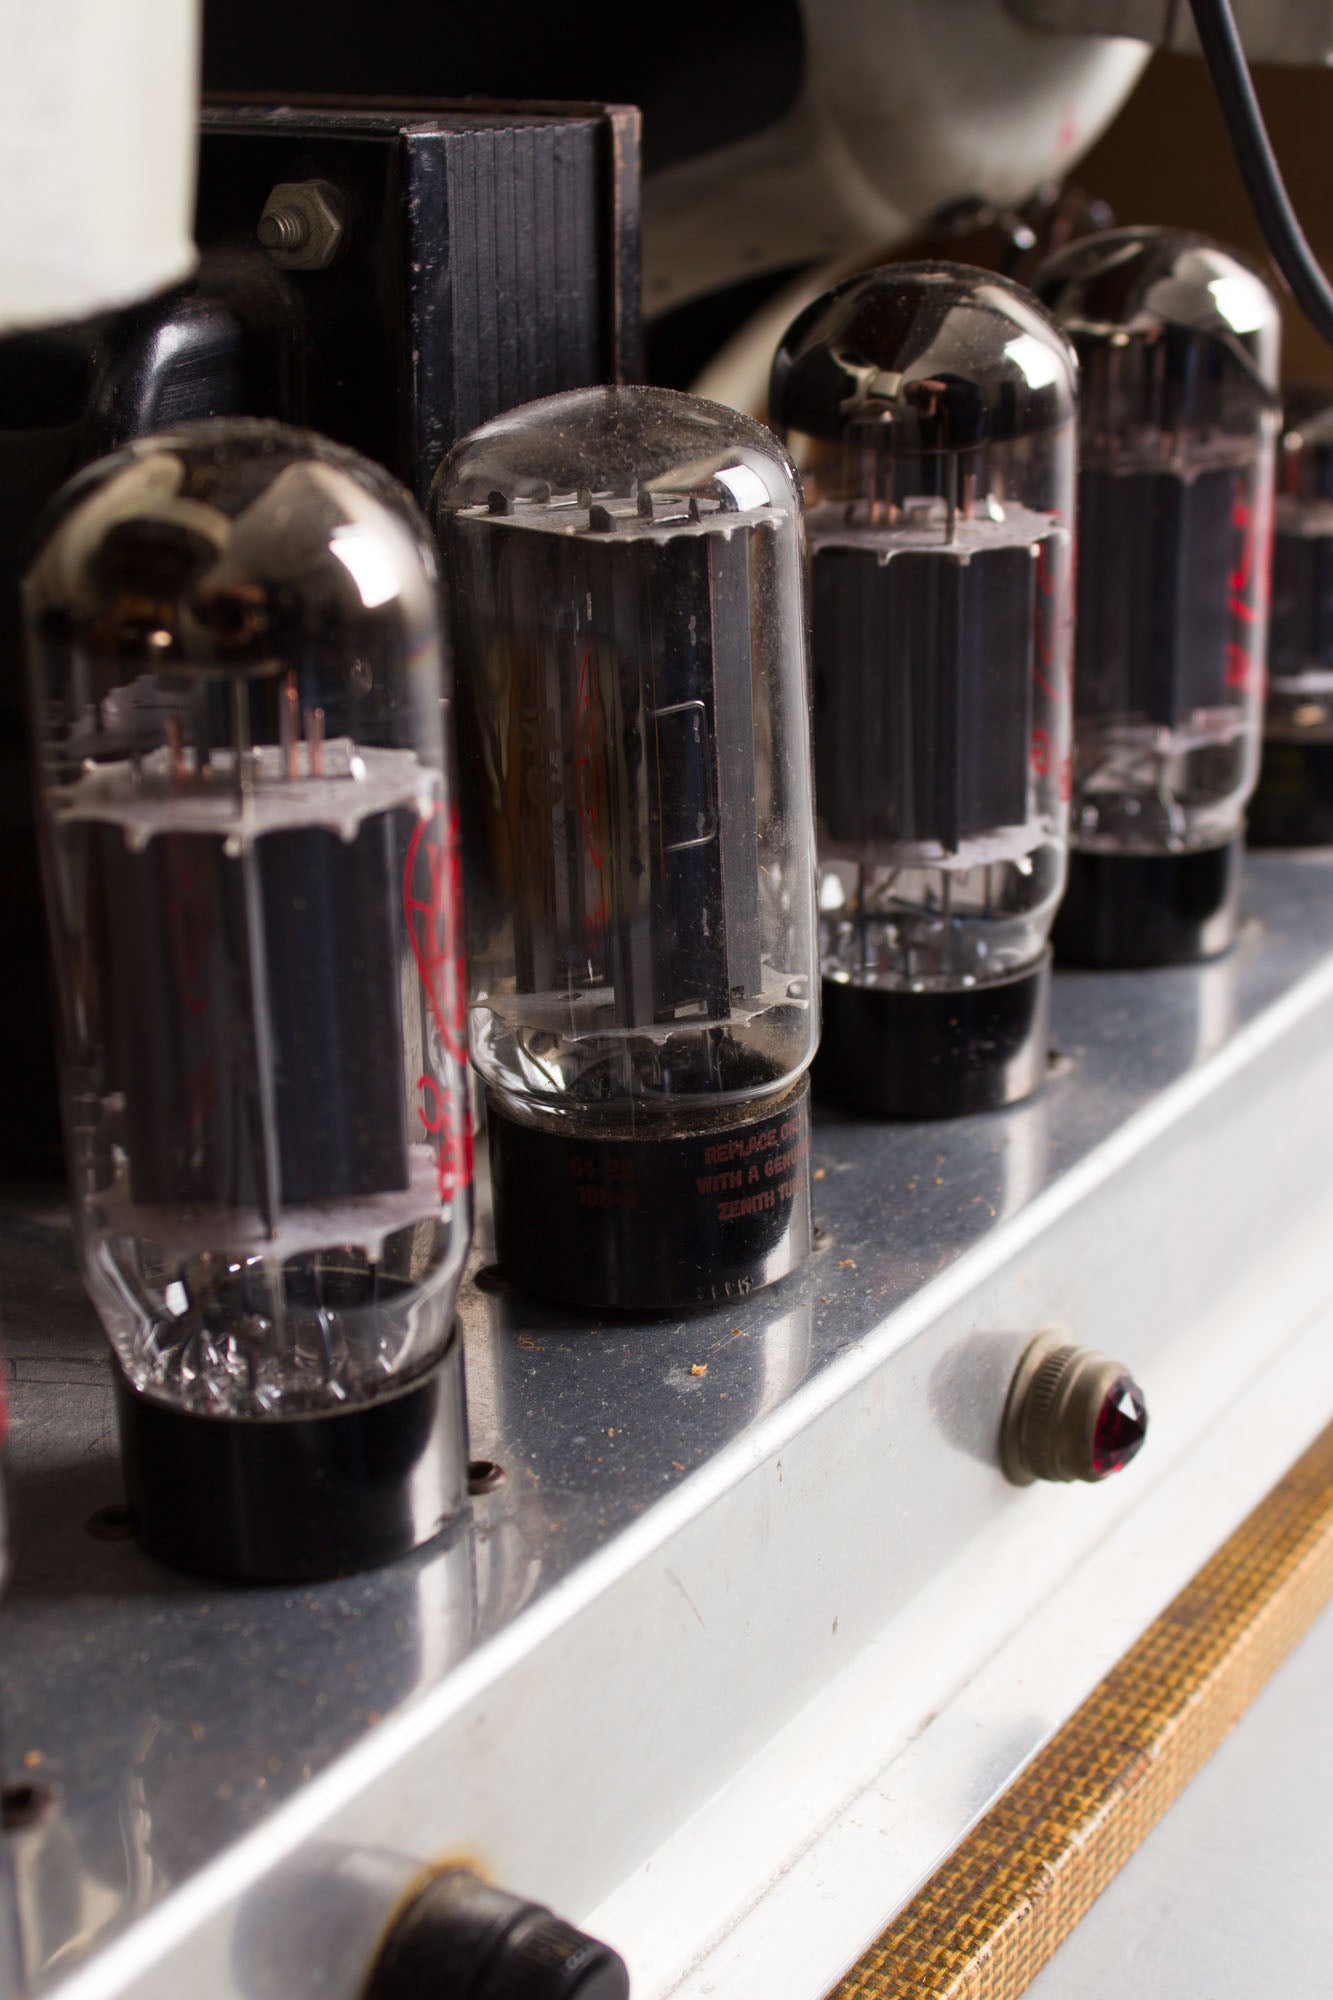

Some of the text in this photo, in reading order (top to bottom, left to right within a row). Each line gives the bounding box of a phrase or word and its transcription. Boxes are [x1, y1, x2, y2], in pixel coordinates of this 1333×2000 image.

[703, 1128, 778, 1167] REPLACE
[696, 1169, 743, 1195] WITH
[748, 1164, 760, 1185] A
[717, 1188, 775, 1221] ZENITH
